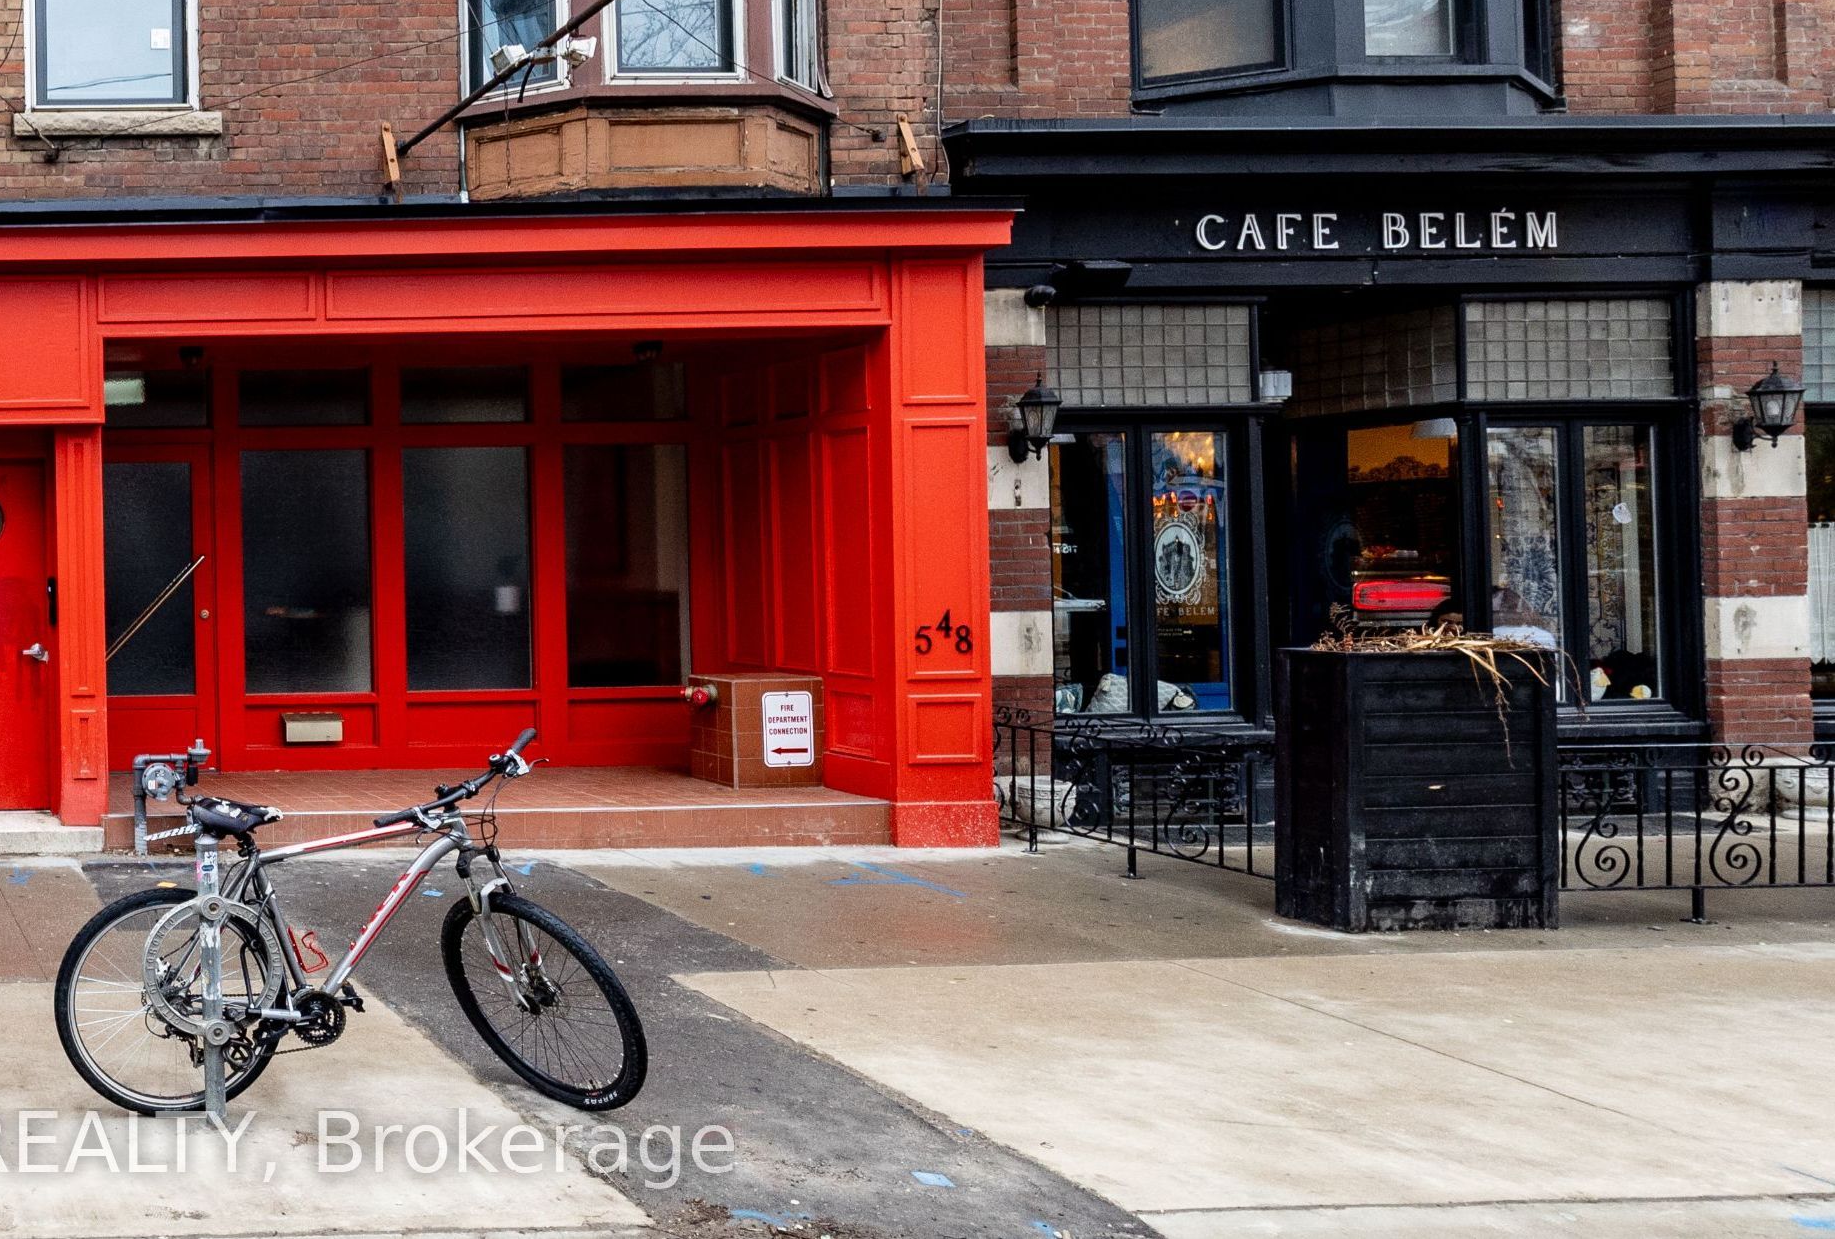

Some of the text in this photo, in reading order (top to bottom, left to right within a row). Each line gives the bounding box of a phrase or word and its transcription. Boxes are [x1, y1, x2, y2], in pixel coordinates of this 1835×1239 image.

[1195, 207, 1559, 251] CAFE BELÉM
[914, 609, 973, 655] 548
[780, 704, 795, 712] FIRE
[768, 715, 808, 724] DEPARTMENT
[768, 727, 808, 736] CONNECTION
